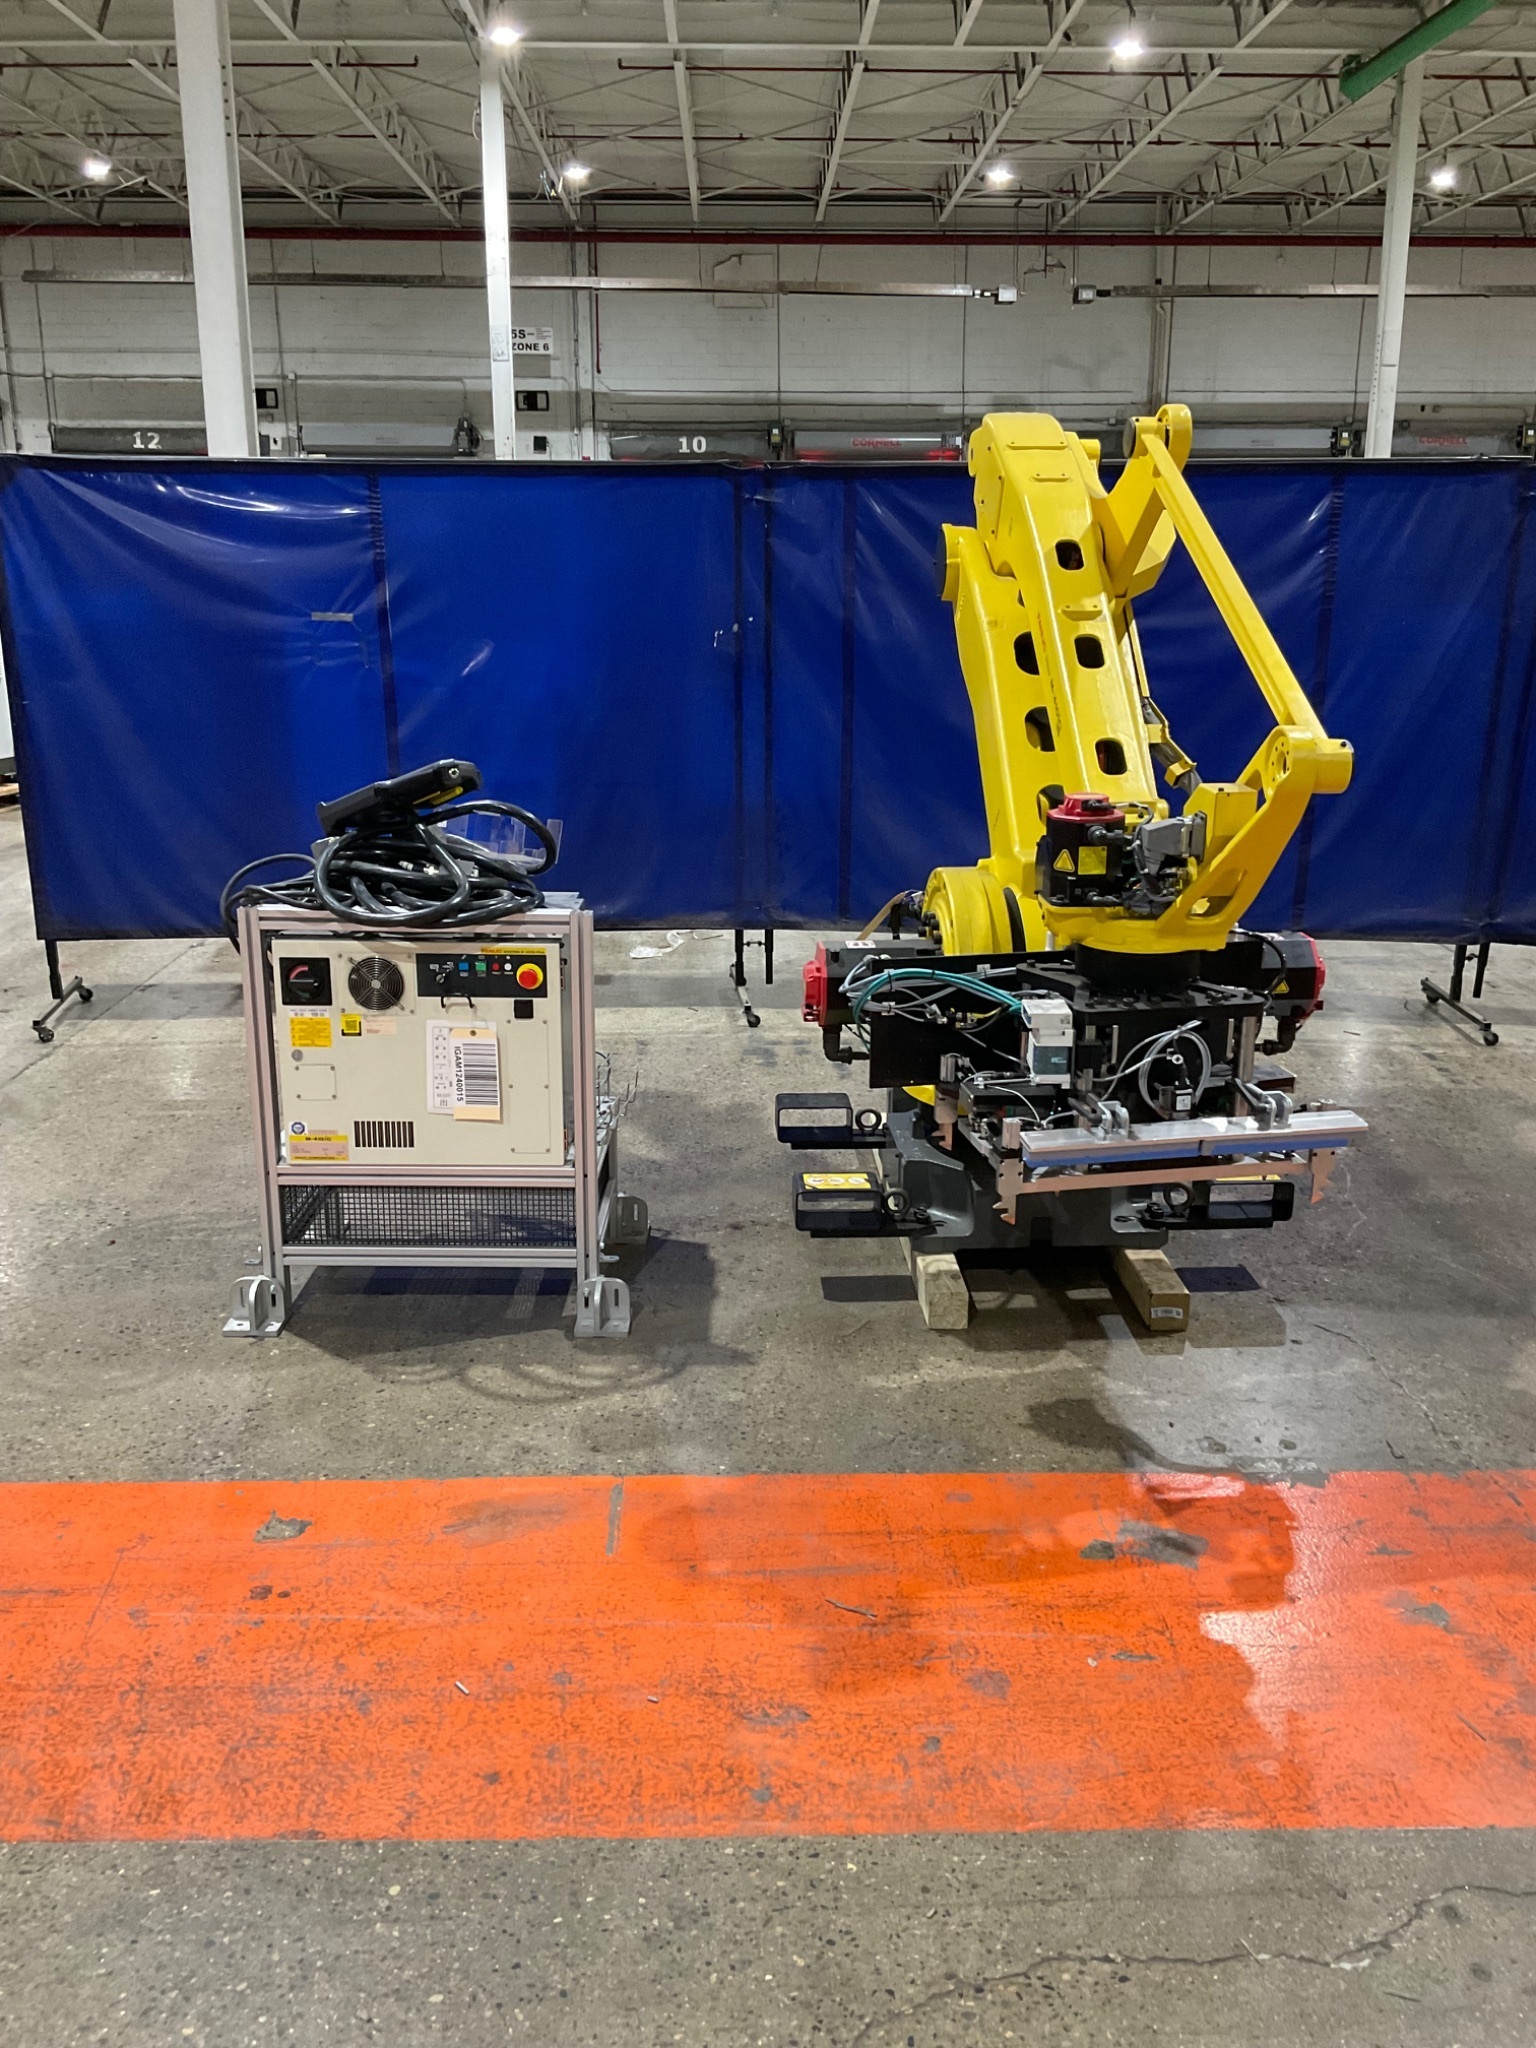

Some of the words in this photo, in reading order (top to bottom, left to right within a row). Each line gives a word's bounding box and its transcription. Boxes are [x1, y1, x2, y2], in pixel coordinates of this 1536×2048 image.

[512, 343, 540, 351] ZONE
[542, 343, 550, 351] 6
[132, 431, 162, 449] 12
[679, 436, 707, 453] 10
[454, 1046, 464, 1102] IGAM1240015
